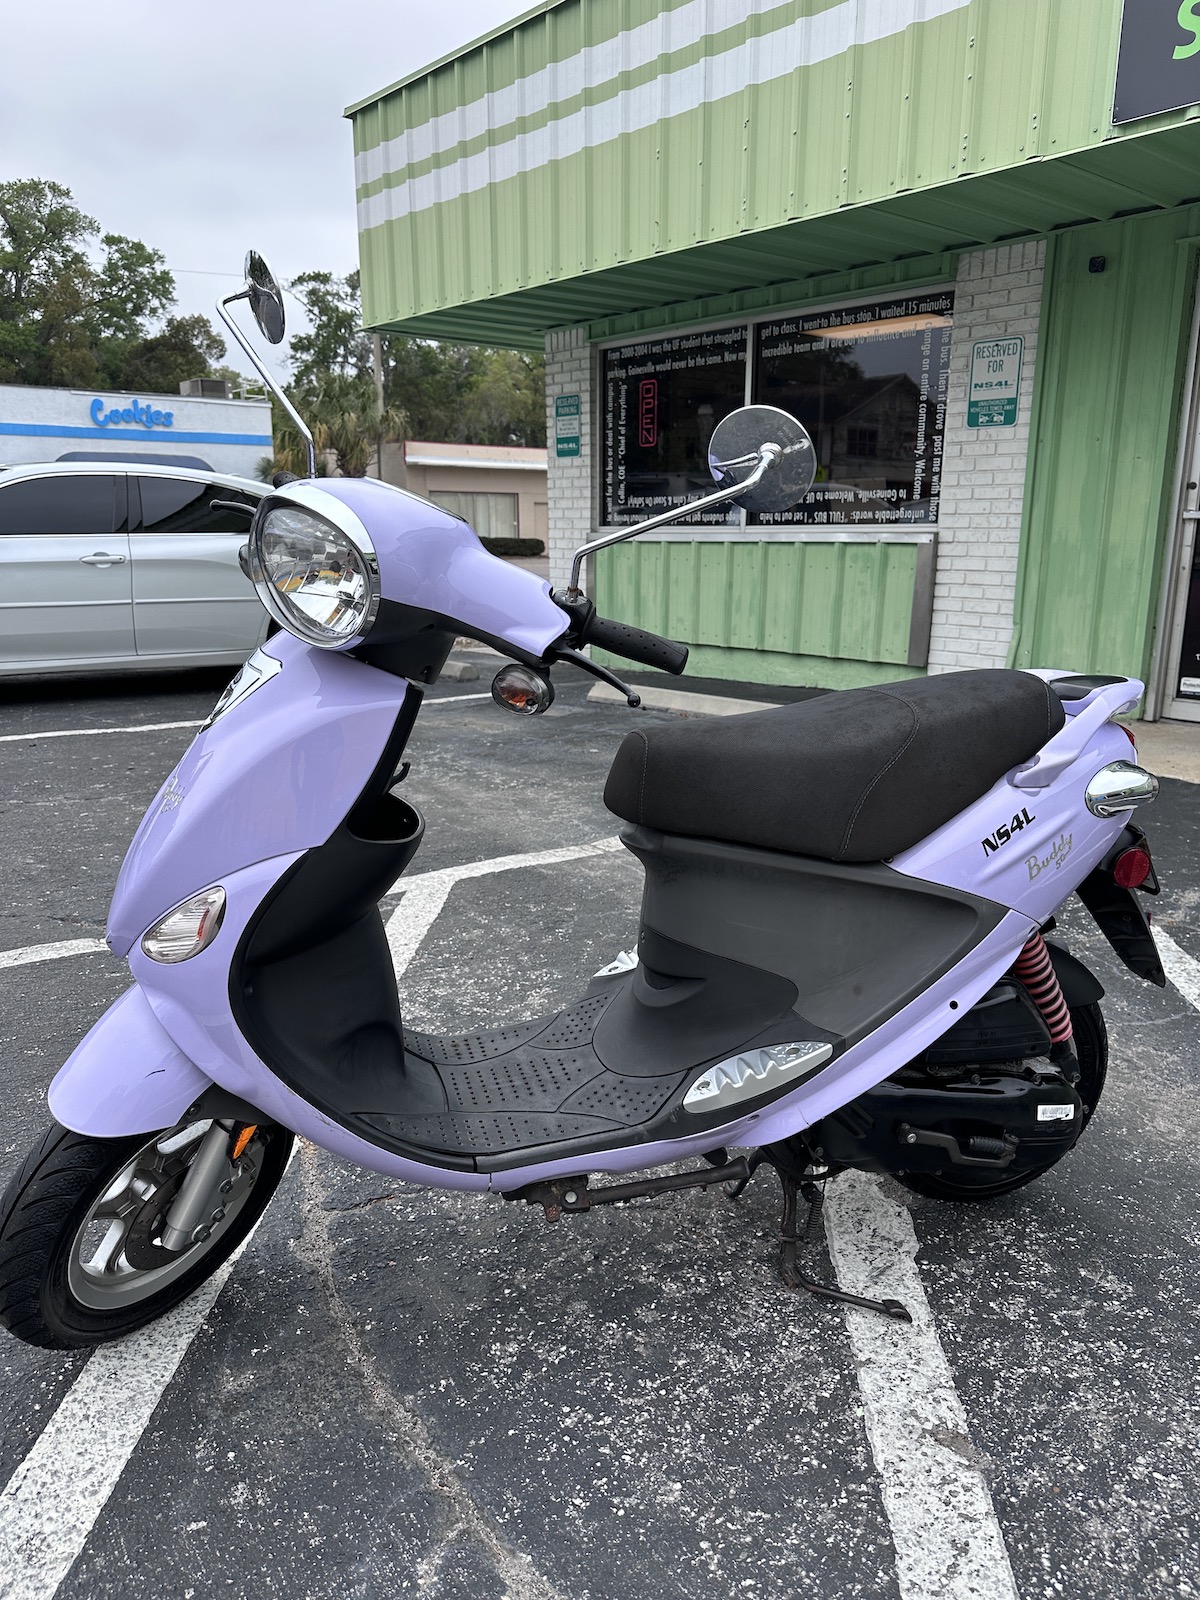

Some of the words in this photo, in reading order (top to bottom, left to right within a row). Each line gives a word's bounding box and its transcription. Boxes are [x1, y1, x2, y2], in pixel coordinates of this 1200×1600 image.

[761, 326, 772, 340] get
[772, 325, 780, 336] to
[780, 322, 798, 334] class.
[804, 319, 820, 331] went
[821, 318, 828, 328] to
[830, 313, 840, 326] the
[842, 312, 856, 324] bus
[880, 301, 906, 318] waited
[908, 301, 918, 314] 15
[920, 299, 951, 313] minutes
[943, 310, 953, 325] for
[762, 341, 793, 358] incredible
[794, 342, 811, 354] team
[812, 336, 825, 350] and
[830, 338, 844, 348] are
[866, 328, 900, 342] influence
[901, 322, 917, 338] and
[921, 322, 936, 356] change
[942, 327, 952, 343] the
[608, 350, 620, 360] From
[652, 344, 662, 354] was
[663, 340, 671, 352] the
[672, 338, 680, 350] UF
[681, 336, 700, 350] student
[702, 334, 714, 346] that
[714, 328, 742, 344] struggled
[976, 342, 1018, 359] RESERVED
[940, 345, 952, 366] bus.
[628, 362, 656, 376] Gainesville
[656, 358, 672, 372] would
[672, 360, 687, 370] never
[688, 356, 696, 368] be
[696, 354, 706, 366] the
[706, 355, 724, 365] same.
[724, 351, 738, 362] Now
[922, 358, 930, 370] an
[987, 360, 1004, 374] FOR
[920, 374, 930, 402] entire
[938, 370, 950, 392] Then
[974, 380, 1013, 389] NS4L
[90, 398, 174, 428] Cookies
[643, 384, 654, 444] OPEN
[935, 403, 948, 430] drove
[618, 426, 626, 434] of
[914, 404, 928, 458] community.
[605, 430, 613, 446] deal
[932, 435, 943, 455] past
[608, 448, 613, 456] or
[618, 465, 626, 480] COE
[932, 458, 940, 472] me
[912, 459, 926, 500] Welcome
[930, 474, 942, 494] with
[604, 485, 612, 496] for
[618, 481, 626, 504] Collin,
[816, 492, 824, 502] to
[824, 491, 855, 504] Welcome
[856, 489, 898, 504] Gainesville.
[899, 489, 907, 500] to
[628, 495, 645, 508] Safely!
[645, 496, 653, 507] On
[654, 496, 667, 507] Scoot
[928, 496, 940, 522] those
[606, 514, 612, 522] to
[702, 513, 724, 525] students
[760, 512, 774, 524] help
[774, 512, 782, 522] to
[782, 512, 792, 522] out
[794, 512, 804, 522] set
[850, 510, 874, 524] words:
[874, 507, 924, 523] unforgettable
[981, 808, 1036, 857] NS4L
[1025, 833, 1072, 882] Buddy
[1056, 855, 1066, 870] 50
